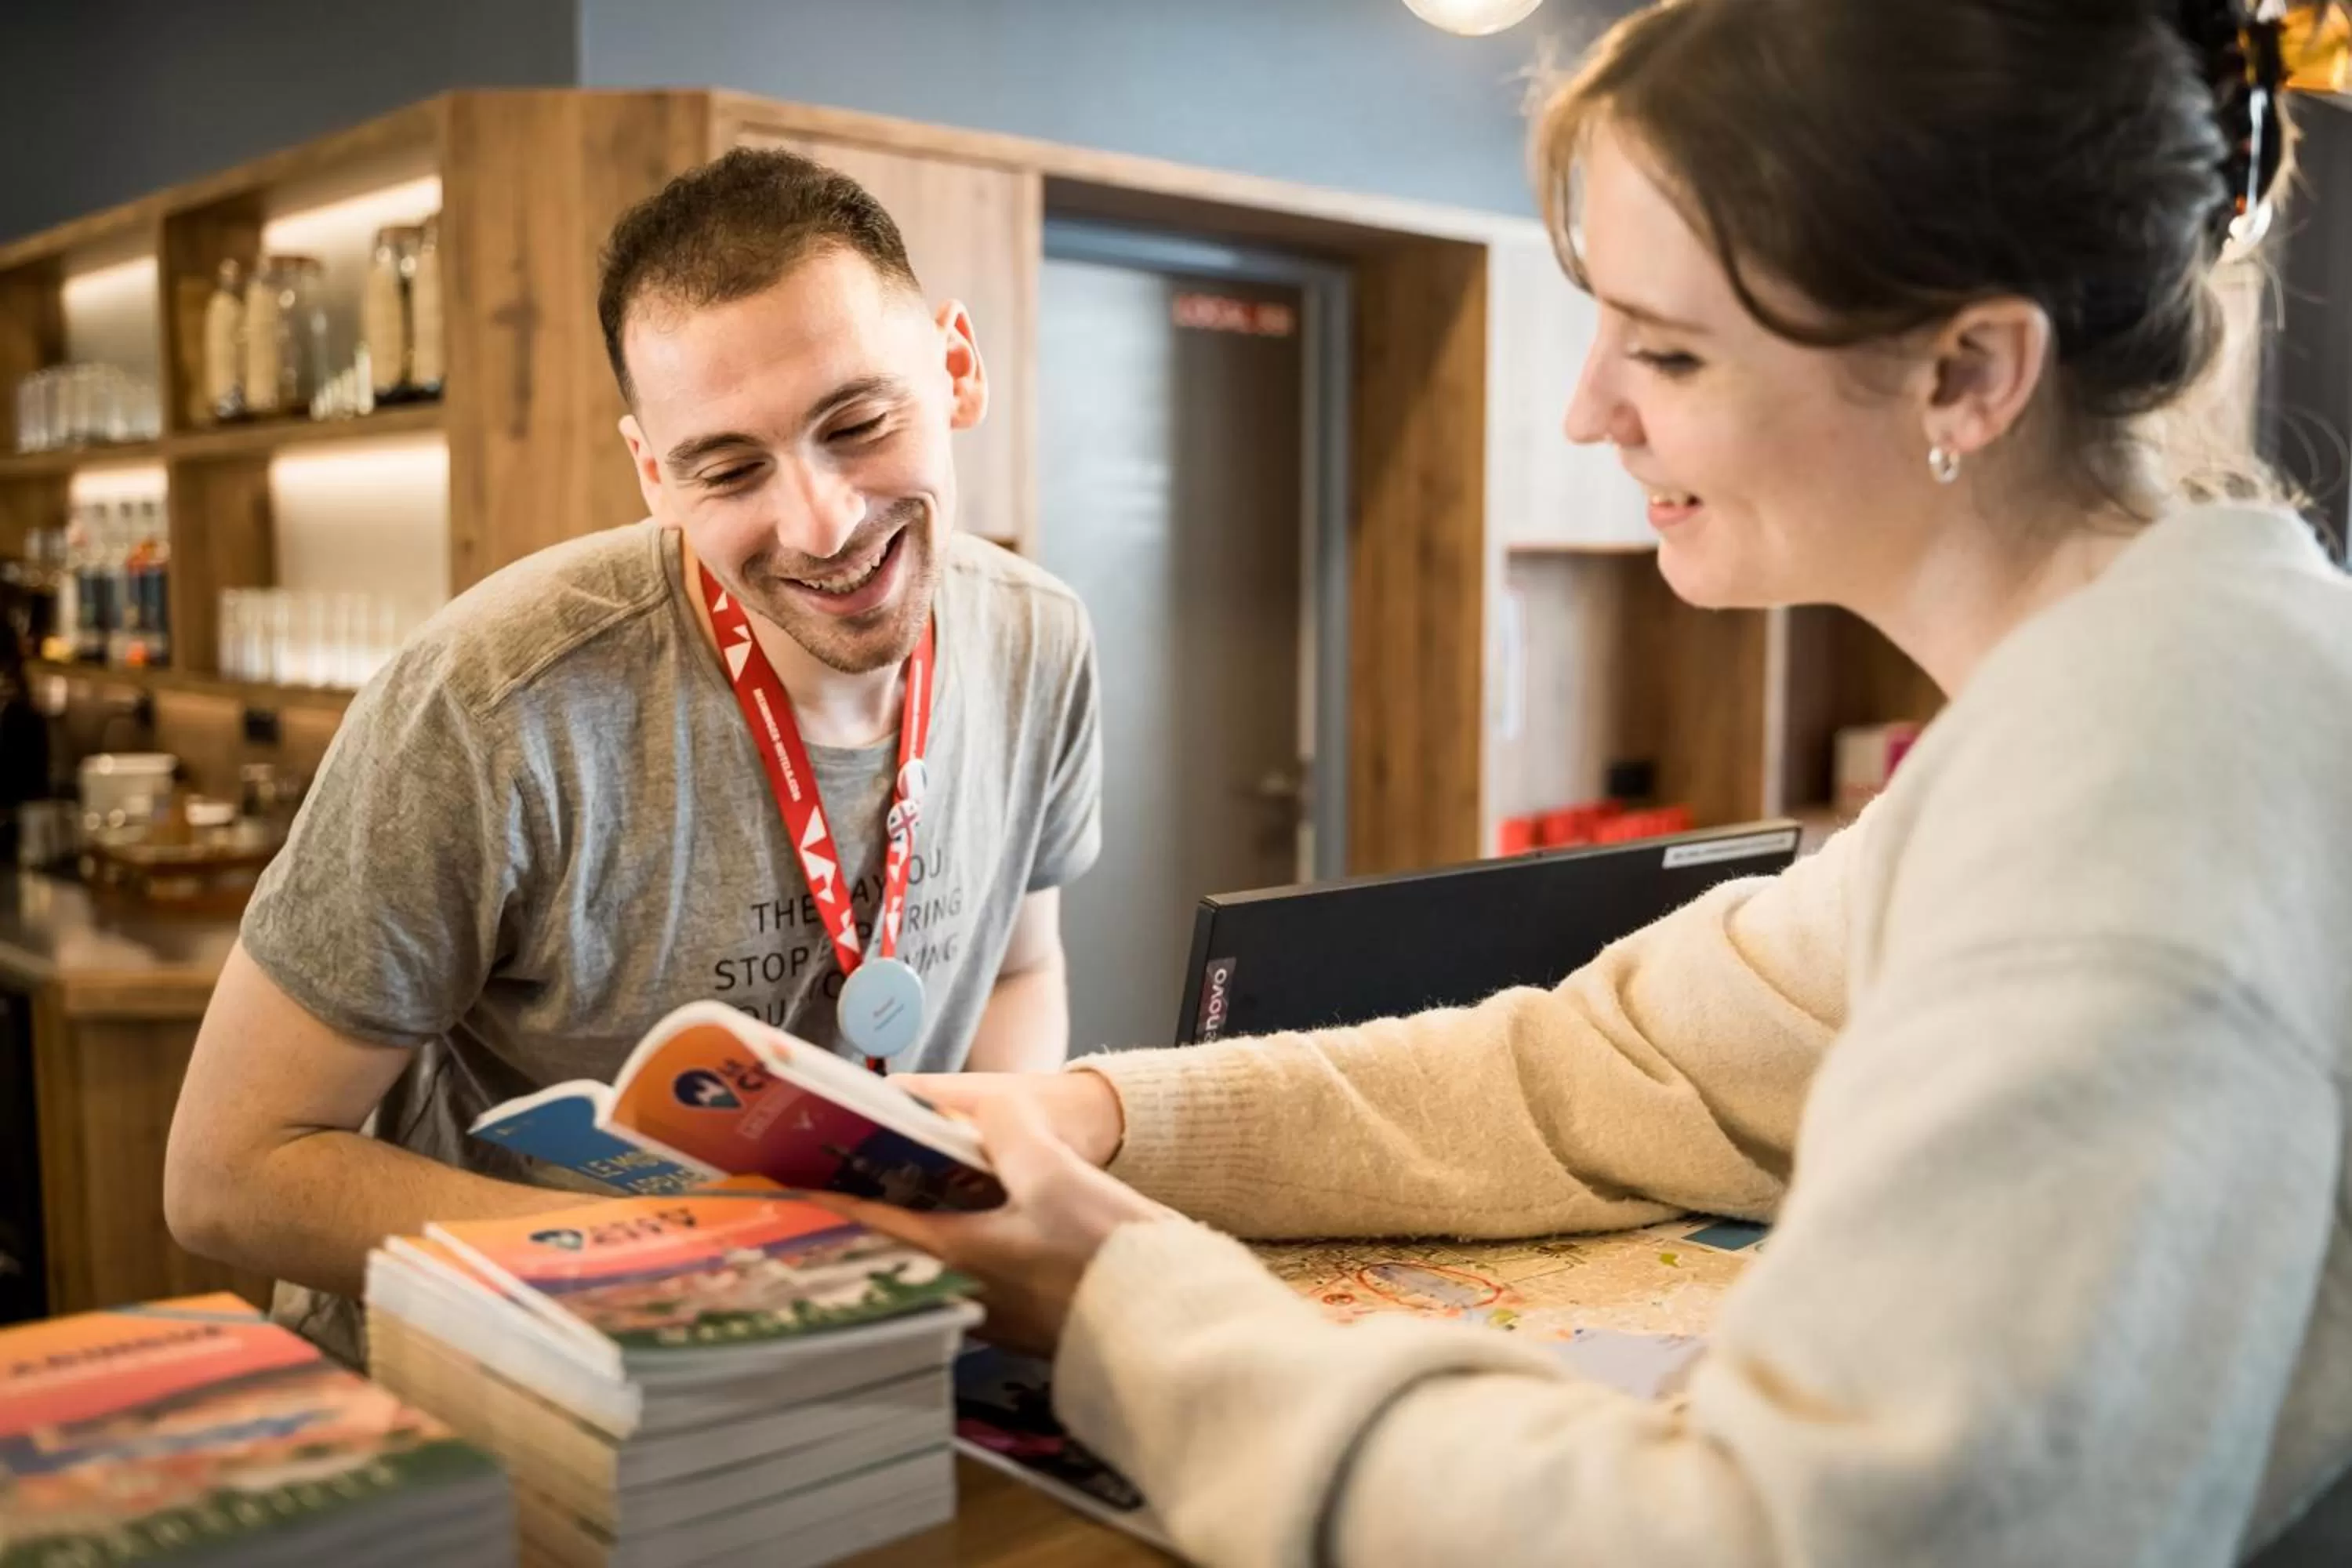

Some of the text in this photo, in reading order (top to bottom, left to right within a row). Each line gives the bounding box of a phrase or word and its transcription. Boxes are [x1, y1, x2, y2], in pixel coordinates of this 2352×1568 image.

[750, 847, 942, 934] THE AY OU
[714, 946, 809, 991] STOP
[1204, 968, 1227, 1041] enovo
